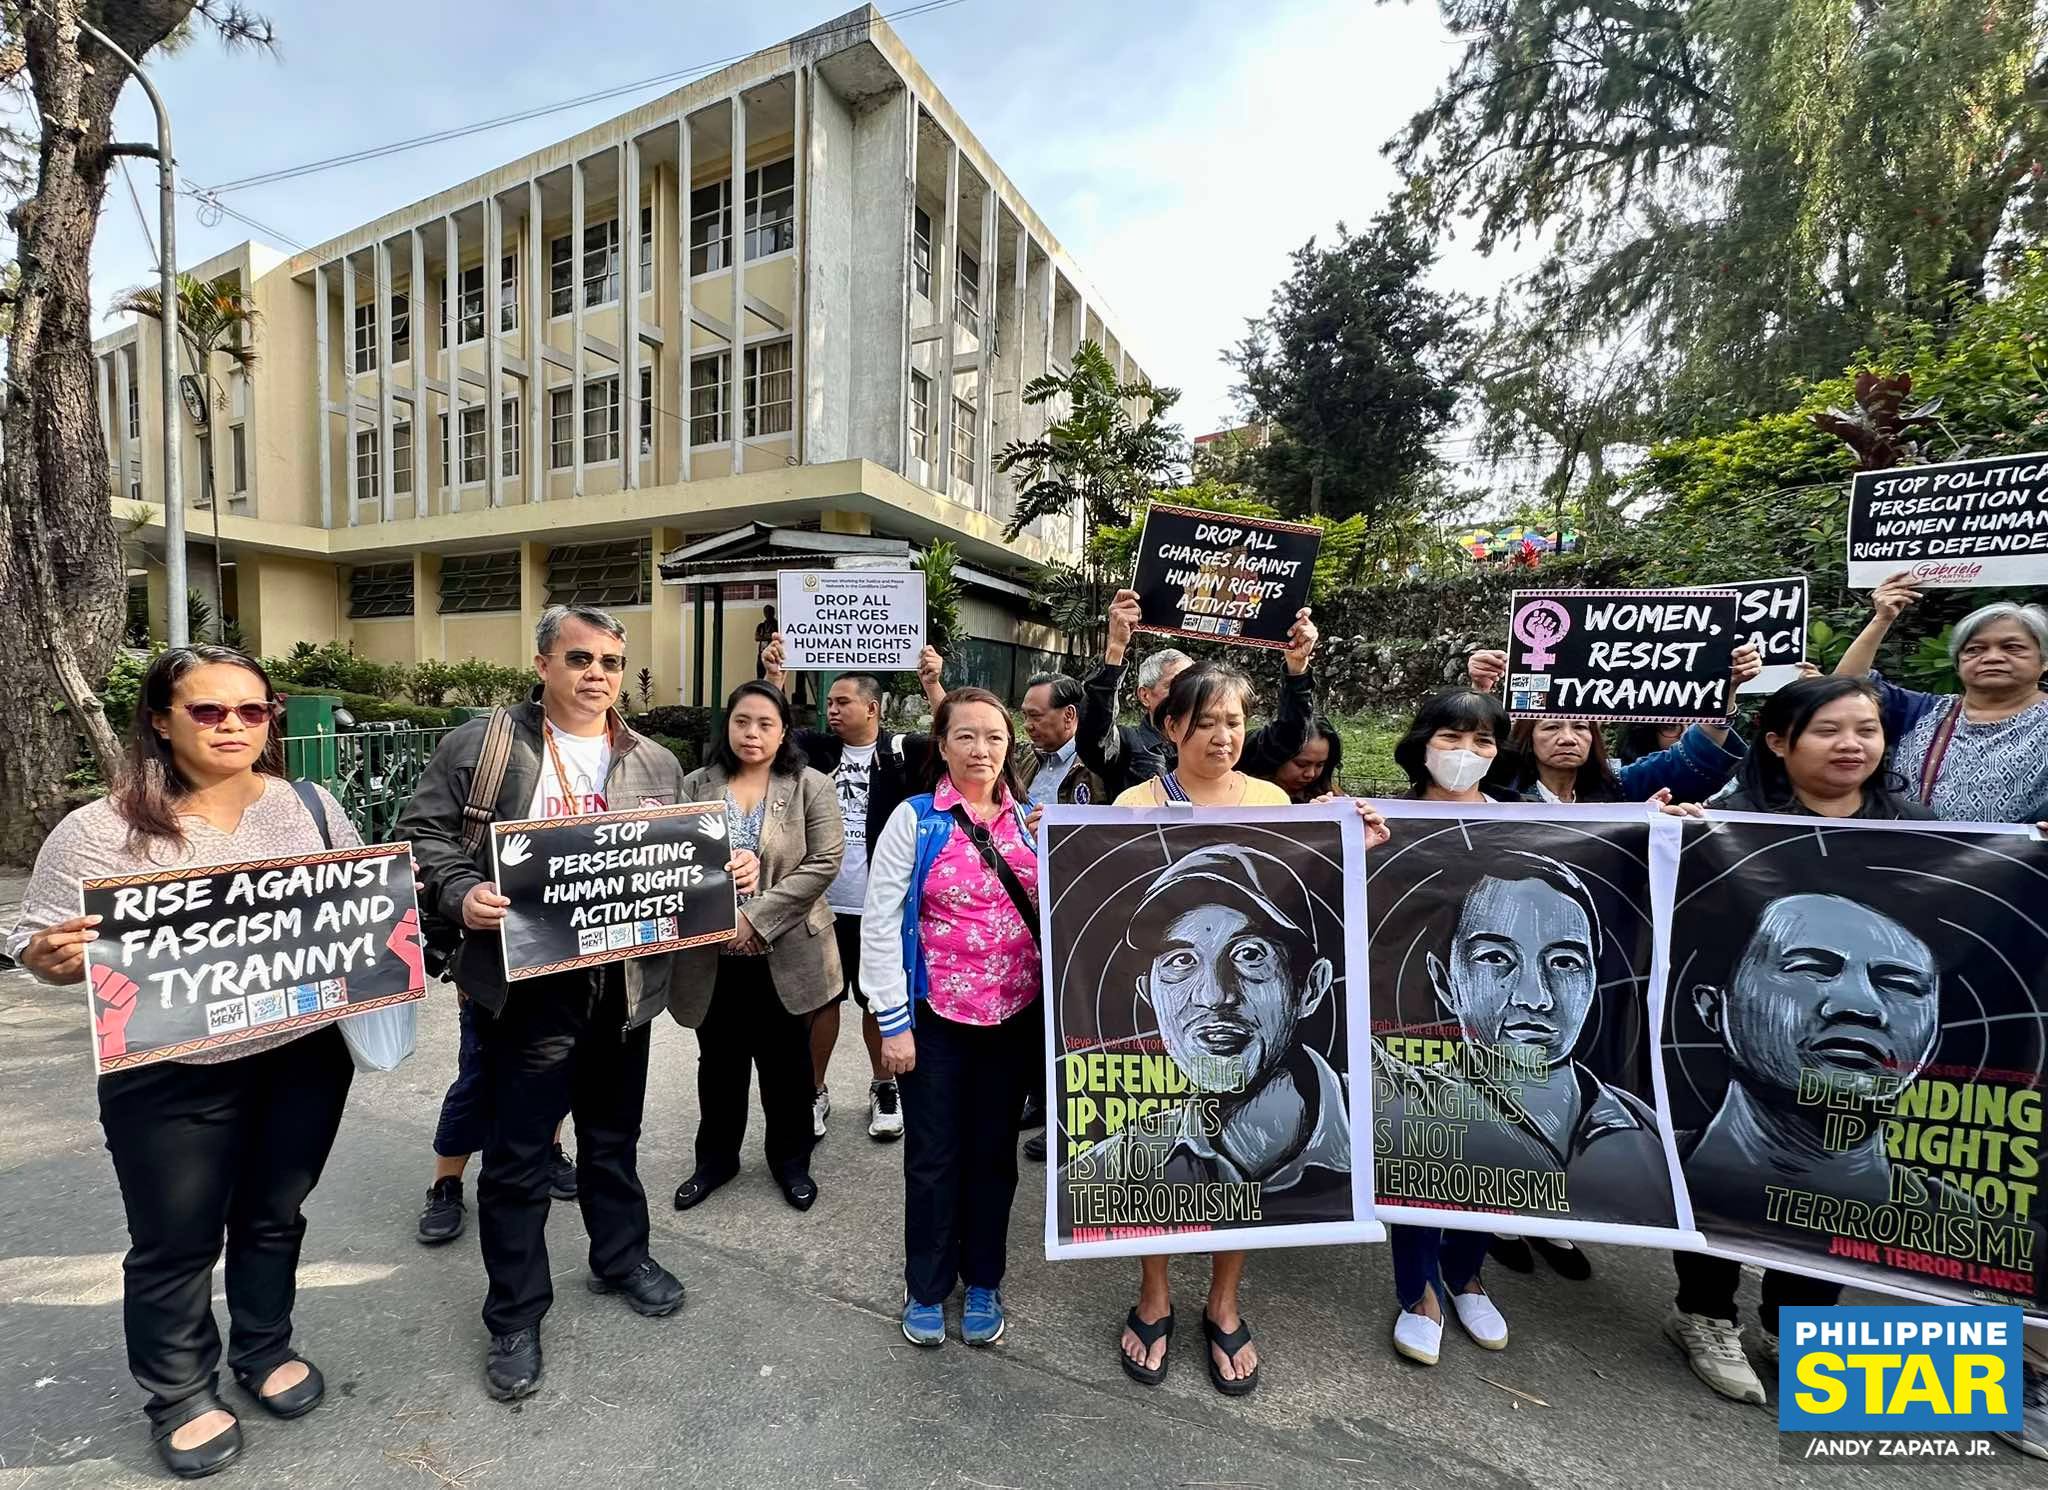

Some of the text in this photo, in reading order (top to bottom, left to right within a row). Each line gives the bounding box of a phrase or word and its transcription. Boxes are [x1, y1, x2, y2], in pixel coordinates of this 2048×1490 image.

[1874, 476, 1928, 496] STOP
[1869, 488, 2030, 518] PERSECUTION
[1195, 524, 1278, 550] DROP ALL
[1876, 517, 1956, 536] WOMEN
[1158, 544, 1301, 578] CHARGES AGAINST
[1854, 532, 2048, 559] RIGHTS DEFENDE
[1165, 568, 1286, 600] HUMAN RIGHTS
[1918, 562, 1982, 578] Gabriela
[814, 594, 890, 606] DROP ALL
[816, 610, 888, 620] CHARGES
[1176, 594, 1262, 619] ACTIVISTS!
[786, 624, 918, 634] AGAINST WOMEN
[1584, 604, 1722, 636] WOMEN,
[794, 638, 911, 649] HUMAN RIGHTS
[806, 652, 900, 664] DEFENDERS!
[1588, 642, 1706, 671] RESIST
[1554, 678, 1726, 709] TYRANNY!
[594, 820, 650, 845] STOP
[548, 841, 696, 878] PERSECUTING
[114, 855, 398, 922] RISE AGAINST
[544, 864, 704, 904] HUMAN RIGHTS
[570, 892, 684, 928] ACTIVISTS!
[121, 896, 395, 966] FASCISM AND
[148, 933, 376, 1008] TYRANNY!
[1066, 1033, 1092, 1049] Steve
[1066, 1054, 1246, 1094] DEFENDING
[1374, 1076, 1526, 1124] P RIGHTS
[1798, 1066, 2042, 1132] DEFENDING
[1066, 1098, 1220, 1136] IP RIGHTS
[1374, 1118, 1468, 1160] S NOT
[1824, 1114, 2040, 1178] IP RIGHTS
[1068, 1140, 1168, 1181] IS NOT
[1069, 1182, 1262, 1224] TERRORISM!
[1890, 1164, 2038, 1224] IS NOT
[1764, 1185, 2035, 1272] TERRORISM!
[1828, 1237, 2033, 1294] JUNK TERROR LAWS!
